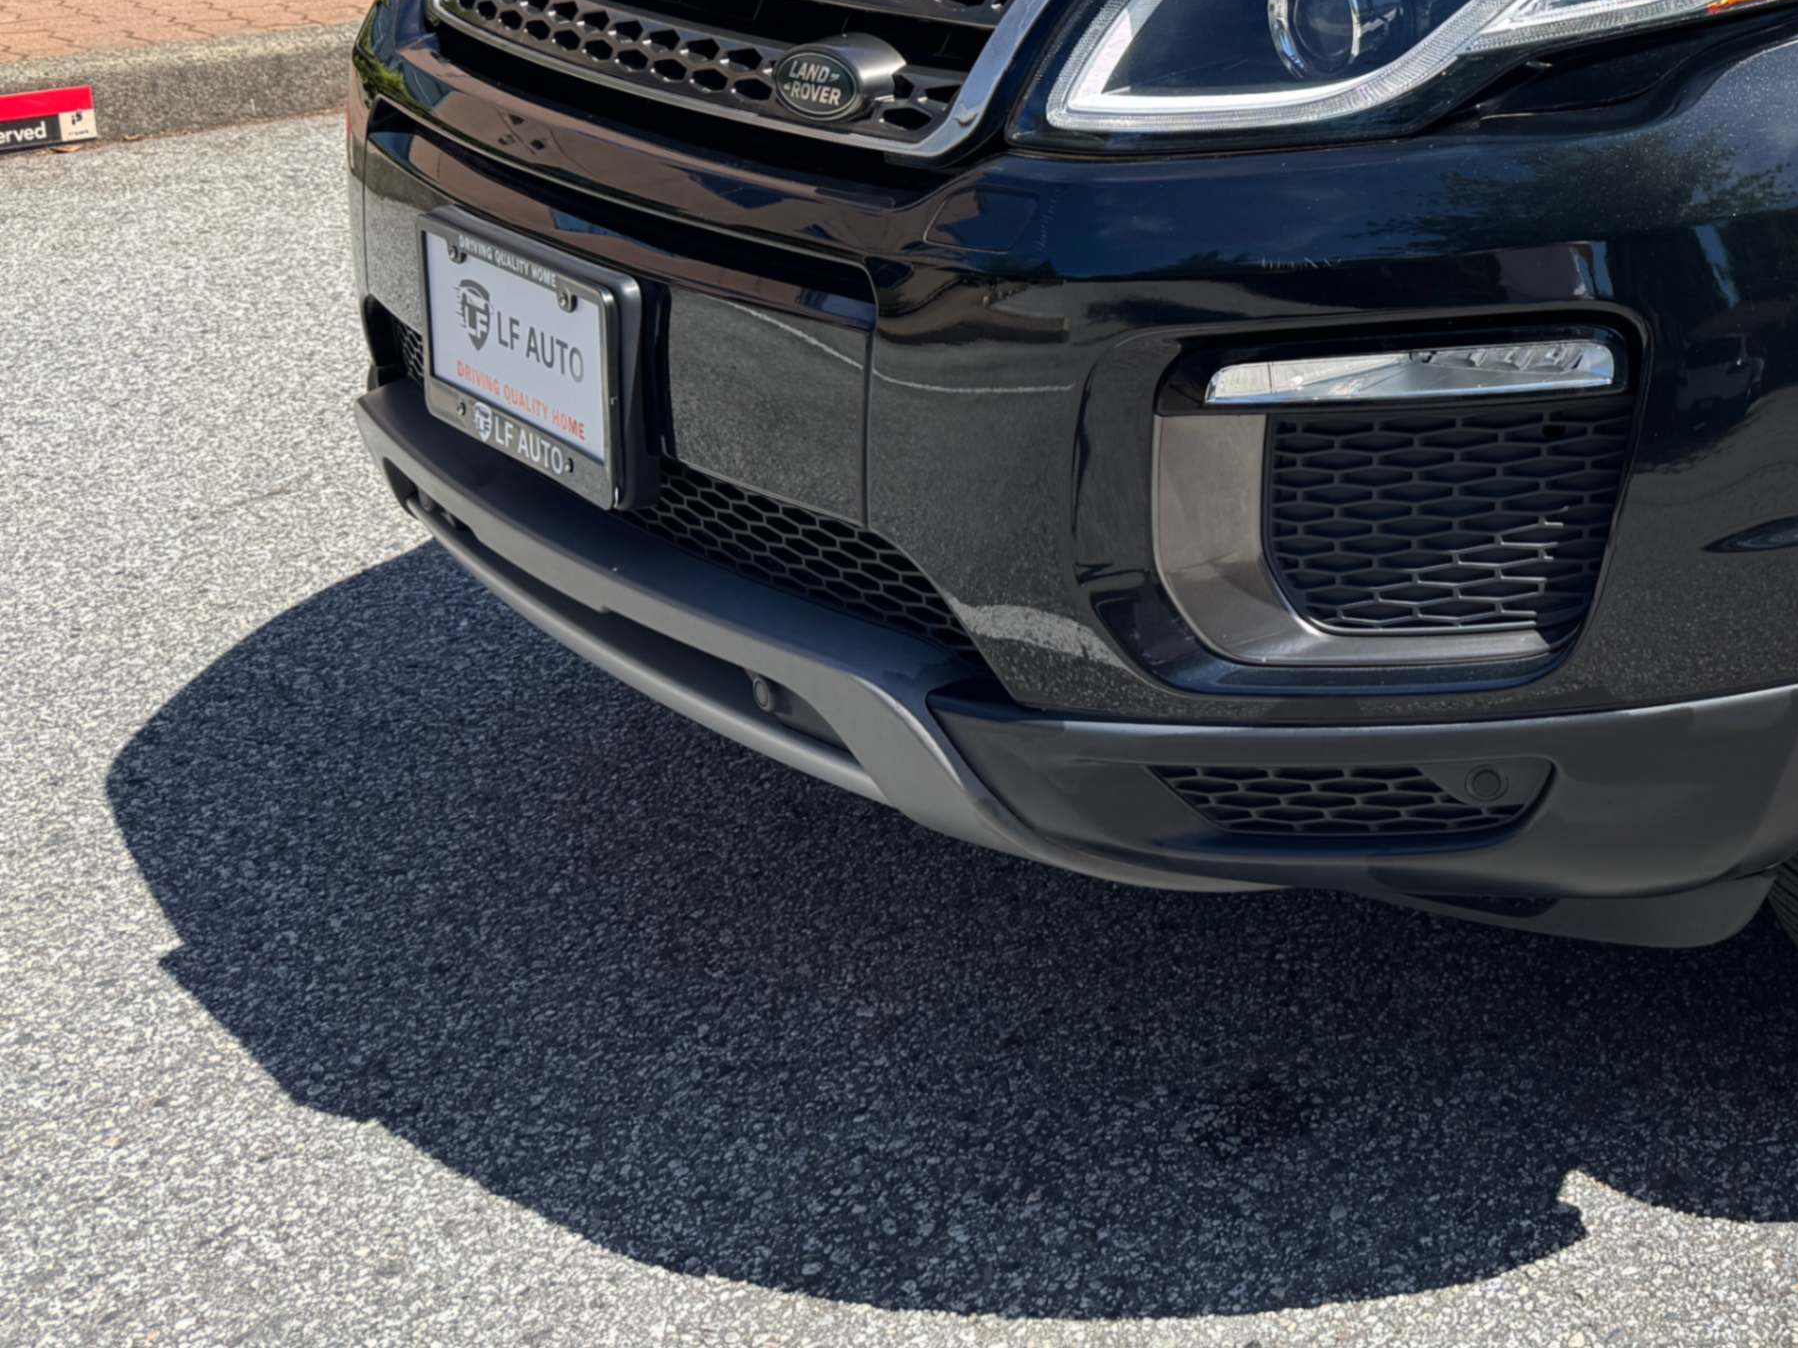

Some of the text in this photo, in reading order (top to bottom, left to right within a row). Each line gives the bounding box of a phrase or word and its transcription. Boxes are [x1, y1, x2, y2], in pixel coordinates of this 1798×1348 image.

[788, 59, 830, 84] LAND
[790, 80, 842, 106] ROVER
[459, 234, 557, 288] DRIVING QUALITY HOME
[497, 311, 584, 383] LF AUTO
[456, 360, 501, 396] DRIVING
[503, 384, 550, 423] QUALITY
[552, 406, 586, 441] HOME
[494, 415, 513, 448] LF
[517, 429, 566, 475] AUTO
